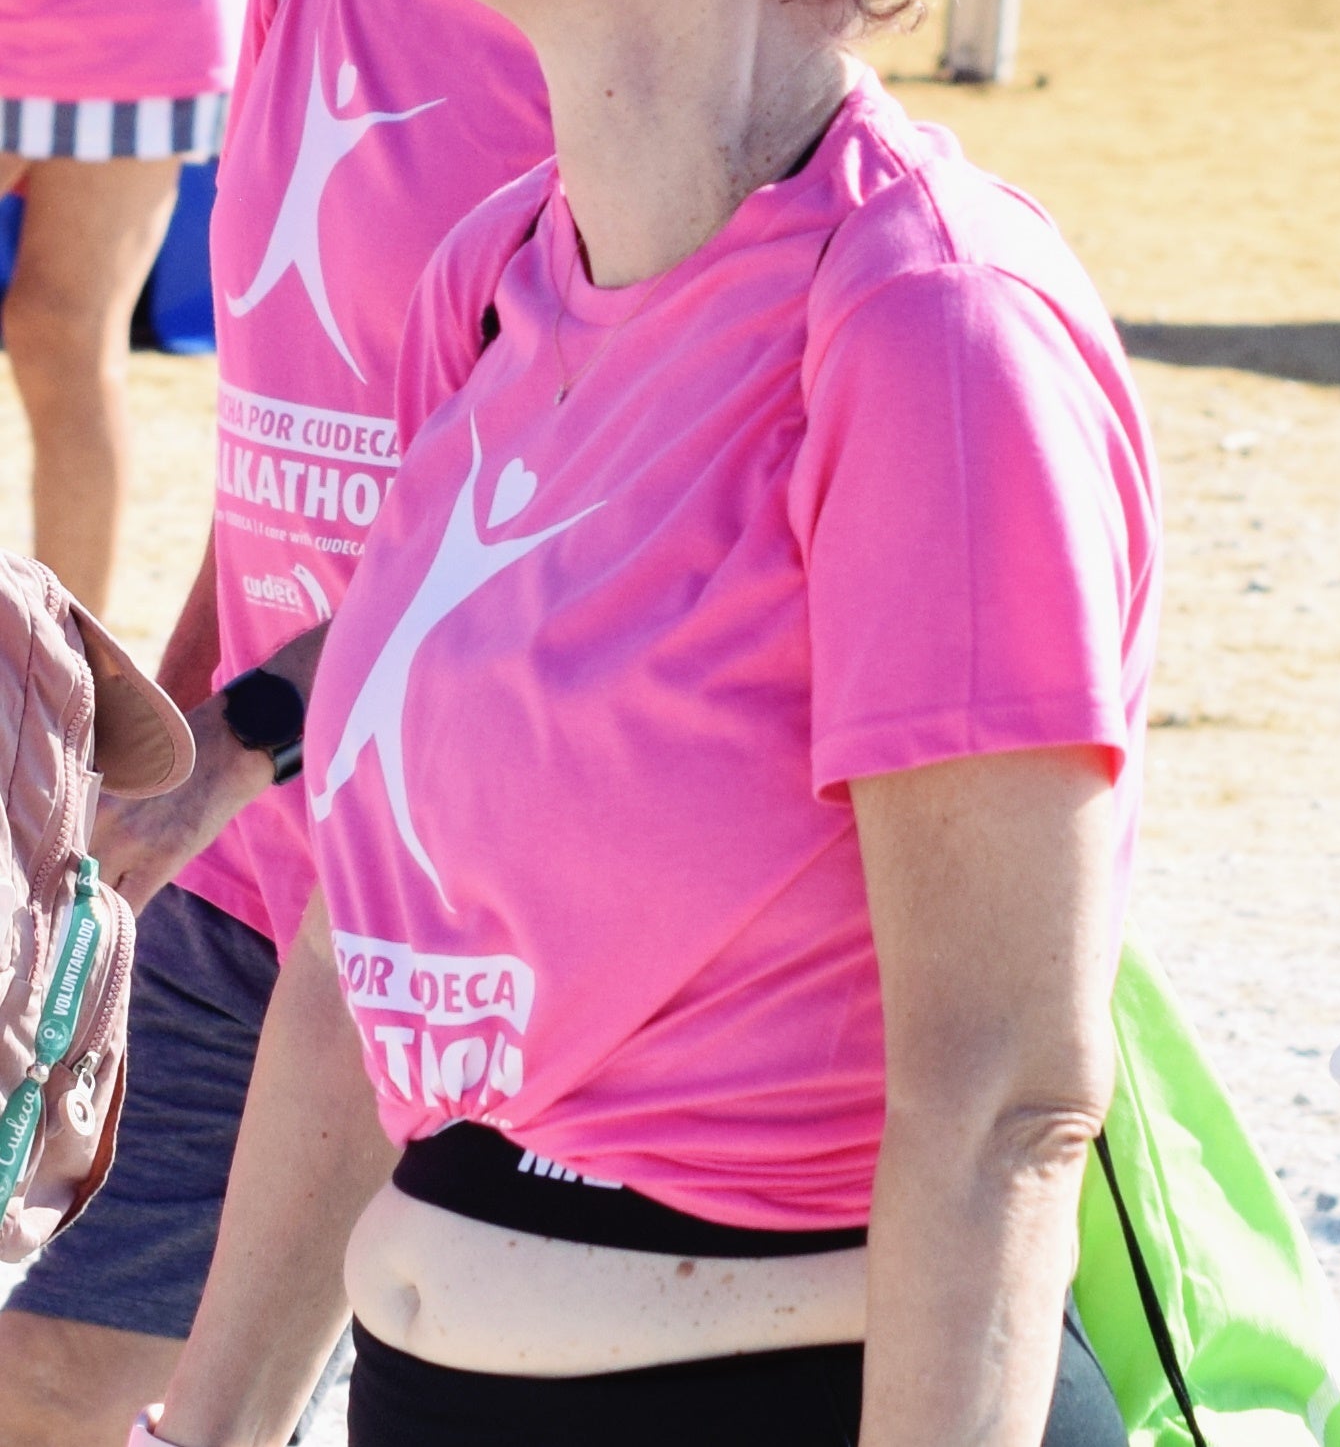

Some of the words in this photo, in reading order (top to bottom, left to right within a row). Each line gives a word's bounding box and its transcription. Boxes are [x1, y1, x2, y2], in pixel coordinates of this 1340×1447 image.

[248, 406, 294, 442] POR
[314, 535, 366, 557] CUDECA
[52, 917, 97, 1017] VOLUNTARIADO
